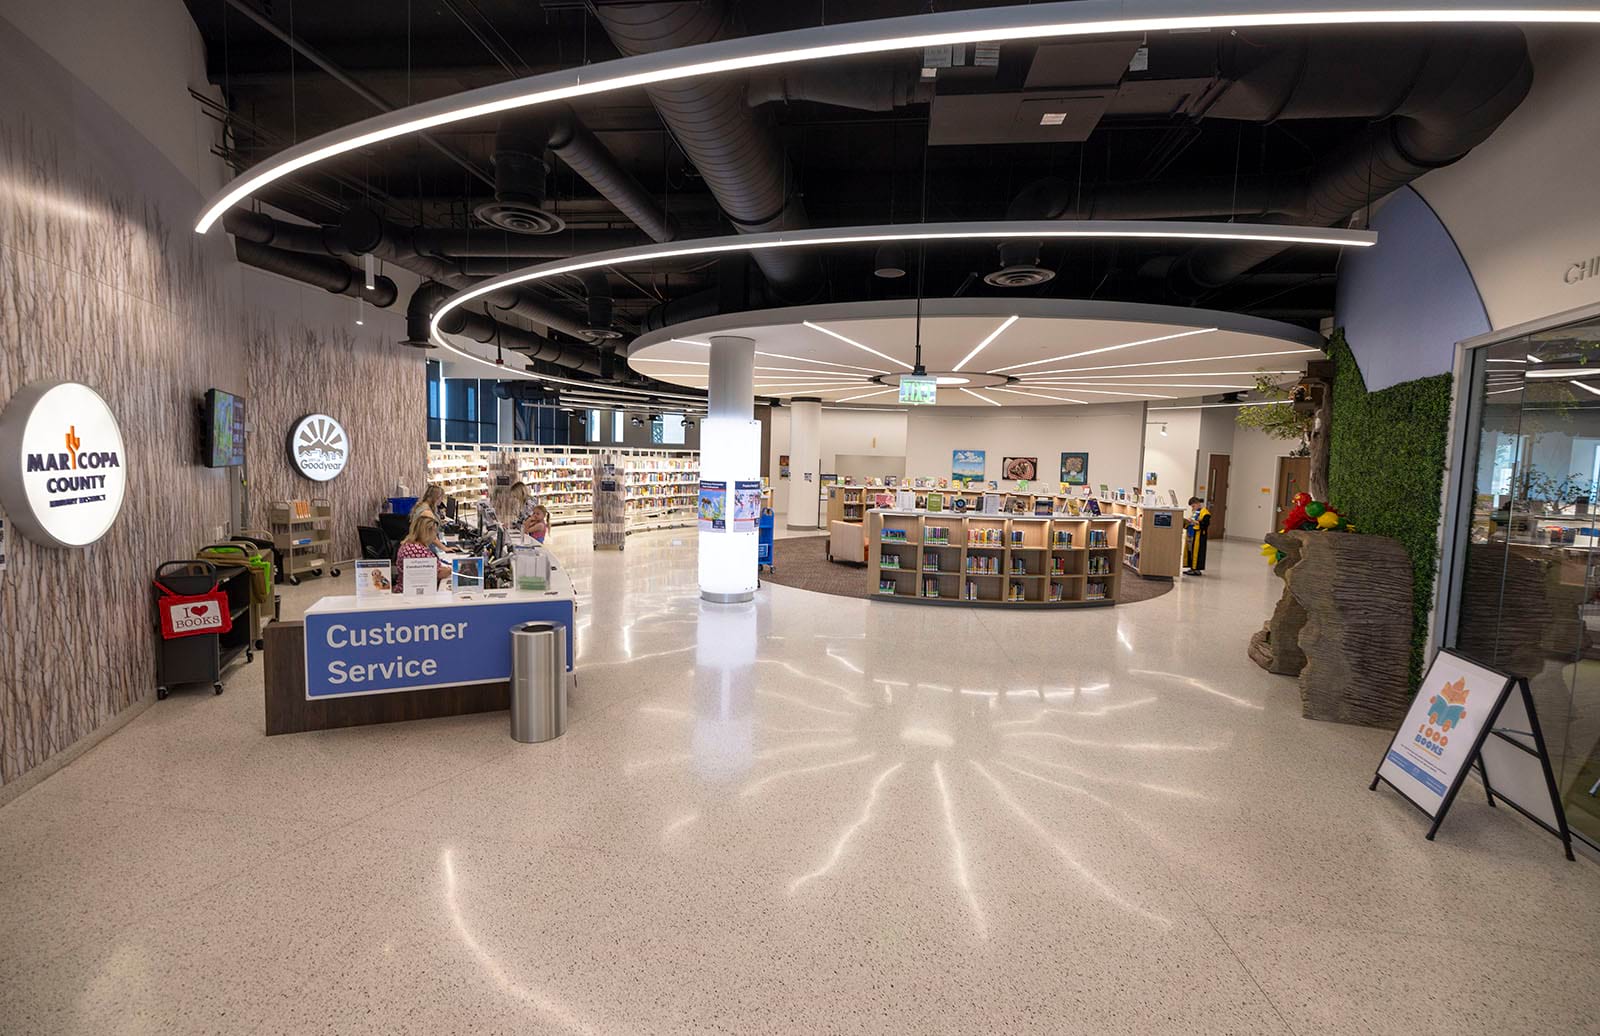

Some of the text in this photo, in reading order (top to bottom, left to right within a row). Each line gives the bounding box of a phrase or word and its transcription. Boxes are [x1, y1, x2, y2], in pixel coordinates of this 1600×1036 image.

[300, 460, 341, 472] Goodyear
[46, 474, 106, 493] COUNTY
[176, 616, 220, 629] BOOKS
[183, 607, 191, 619] I
[326, 621, 468, 648] Customer
[327, 656, 438, 684] Service
[1414, 734, 1445, 757] BOOKS
[1418, 724, 1449, 747] 1000
